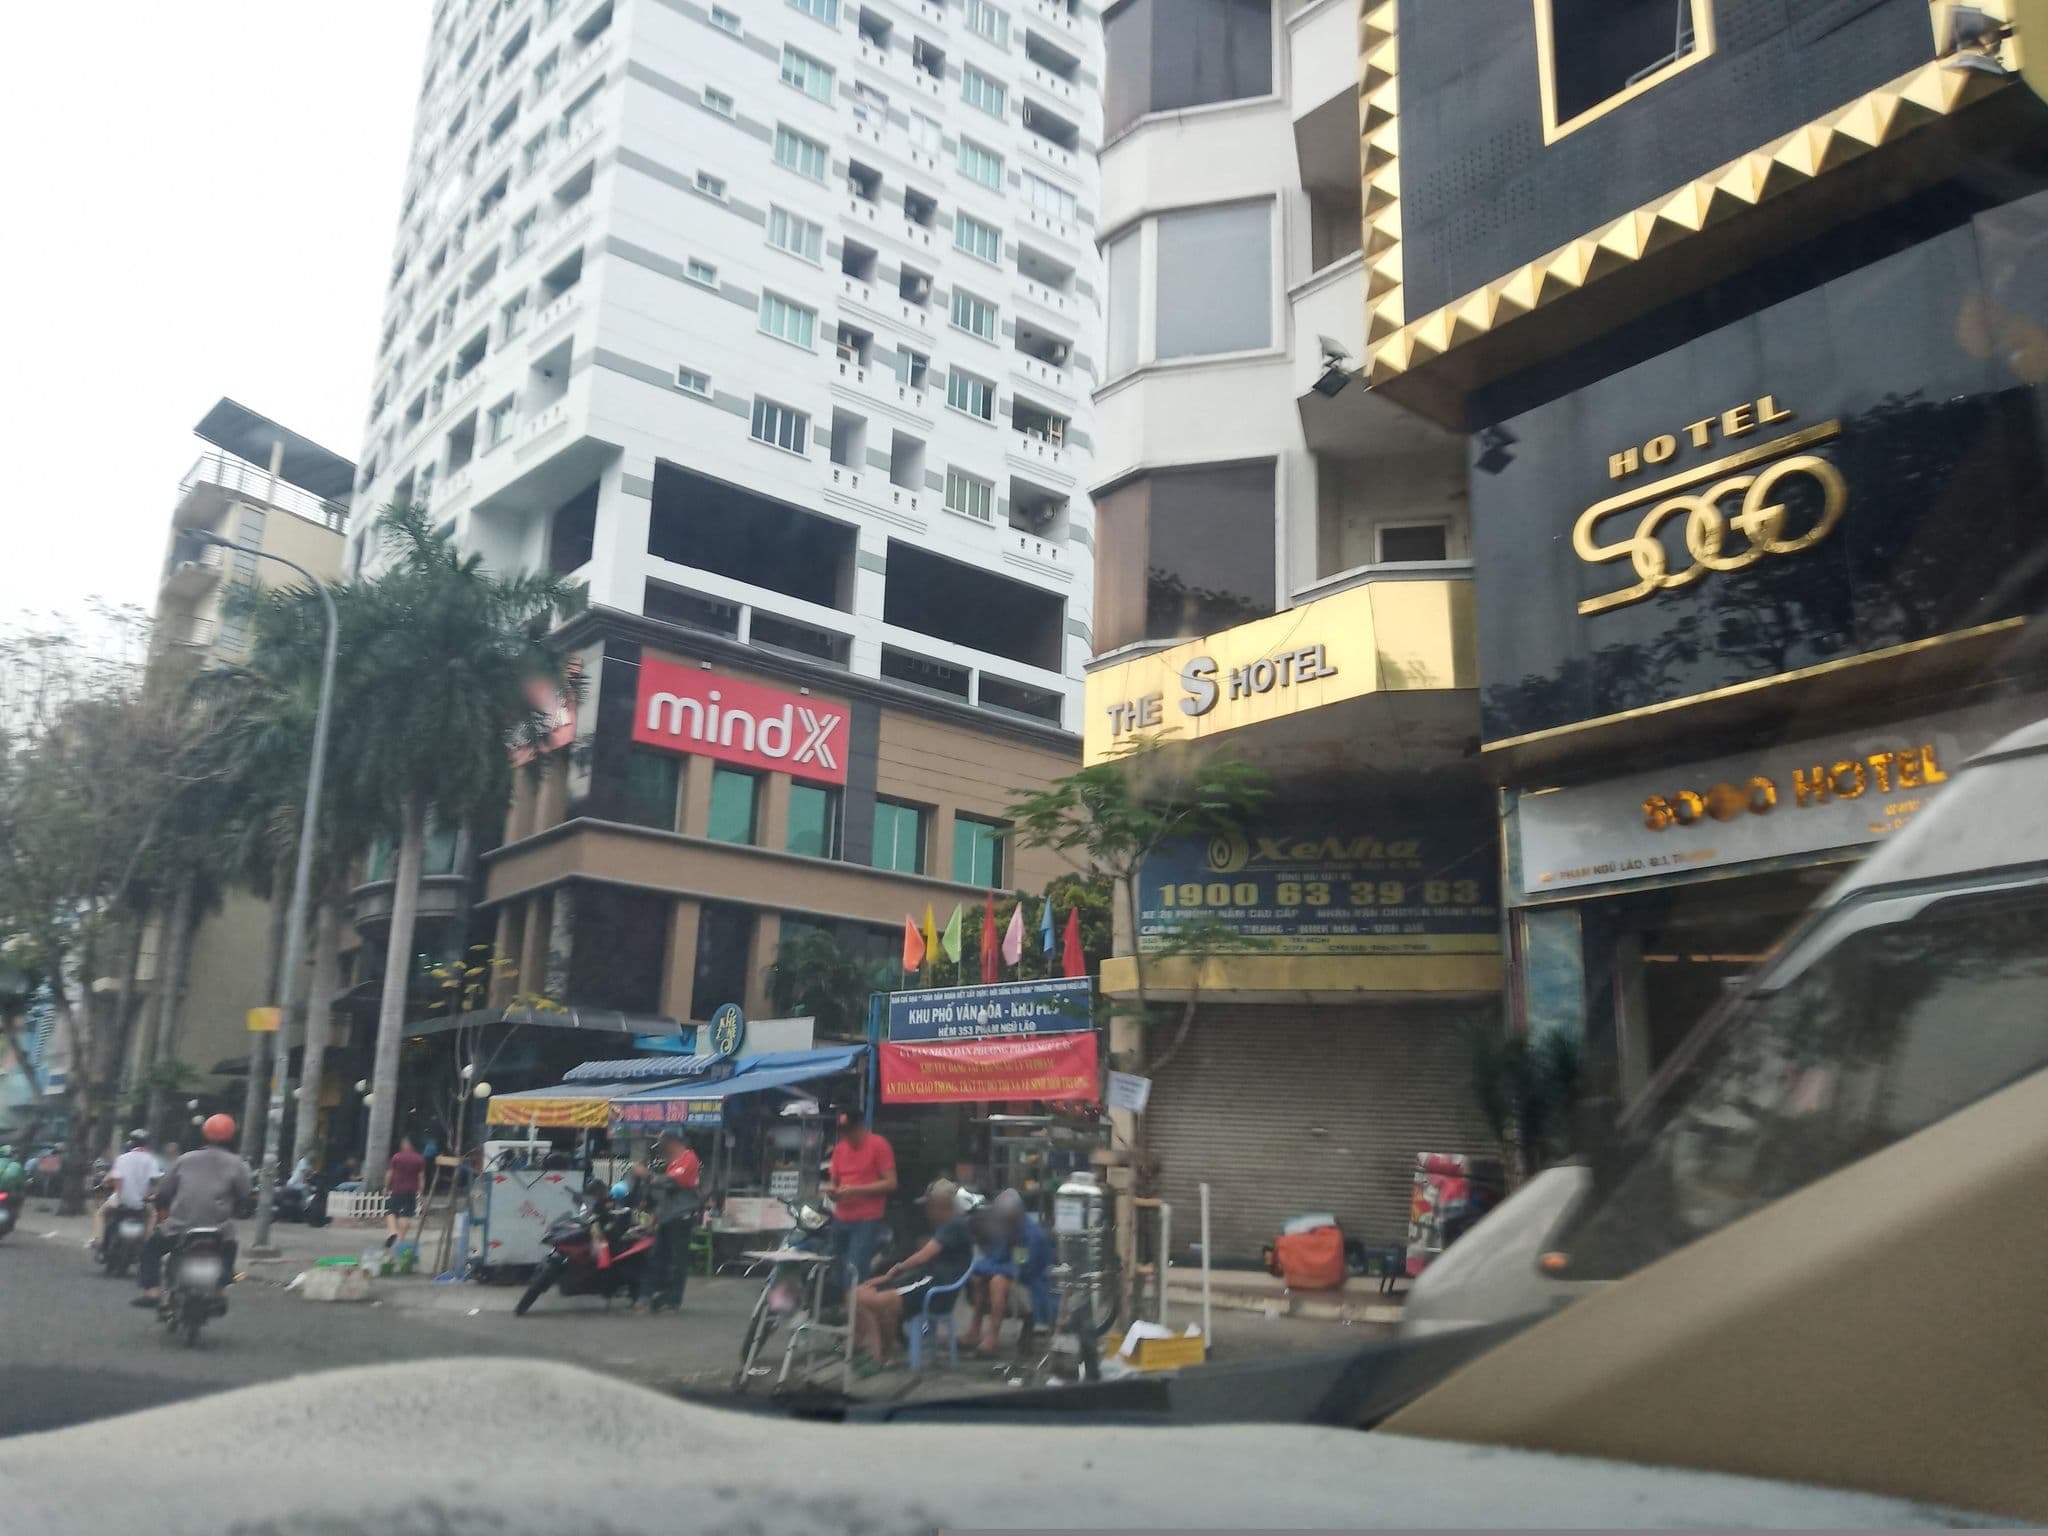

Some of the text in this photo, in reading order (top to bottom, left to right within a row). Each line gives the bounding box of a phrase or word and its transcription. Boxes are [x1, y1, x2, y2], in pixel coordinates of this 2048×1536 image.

[1608, 394, 1791, 480] HOTEL
[1573, 418, 1847, 615] SOGO
[647, 690, 841, 770] mindX
[1106, 643, 1339, 736] THE S HOTEL
[1642, 744, 1948, 832] SOO HOTEL
[1160, 879, 1480, 907] 1900 63 39 63
[908, 1008, 930, 1025] KHU
[932, 1001, 955, 1023] PHỐ
[958, 1025, 973, 1036] 353
